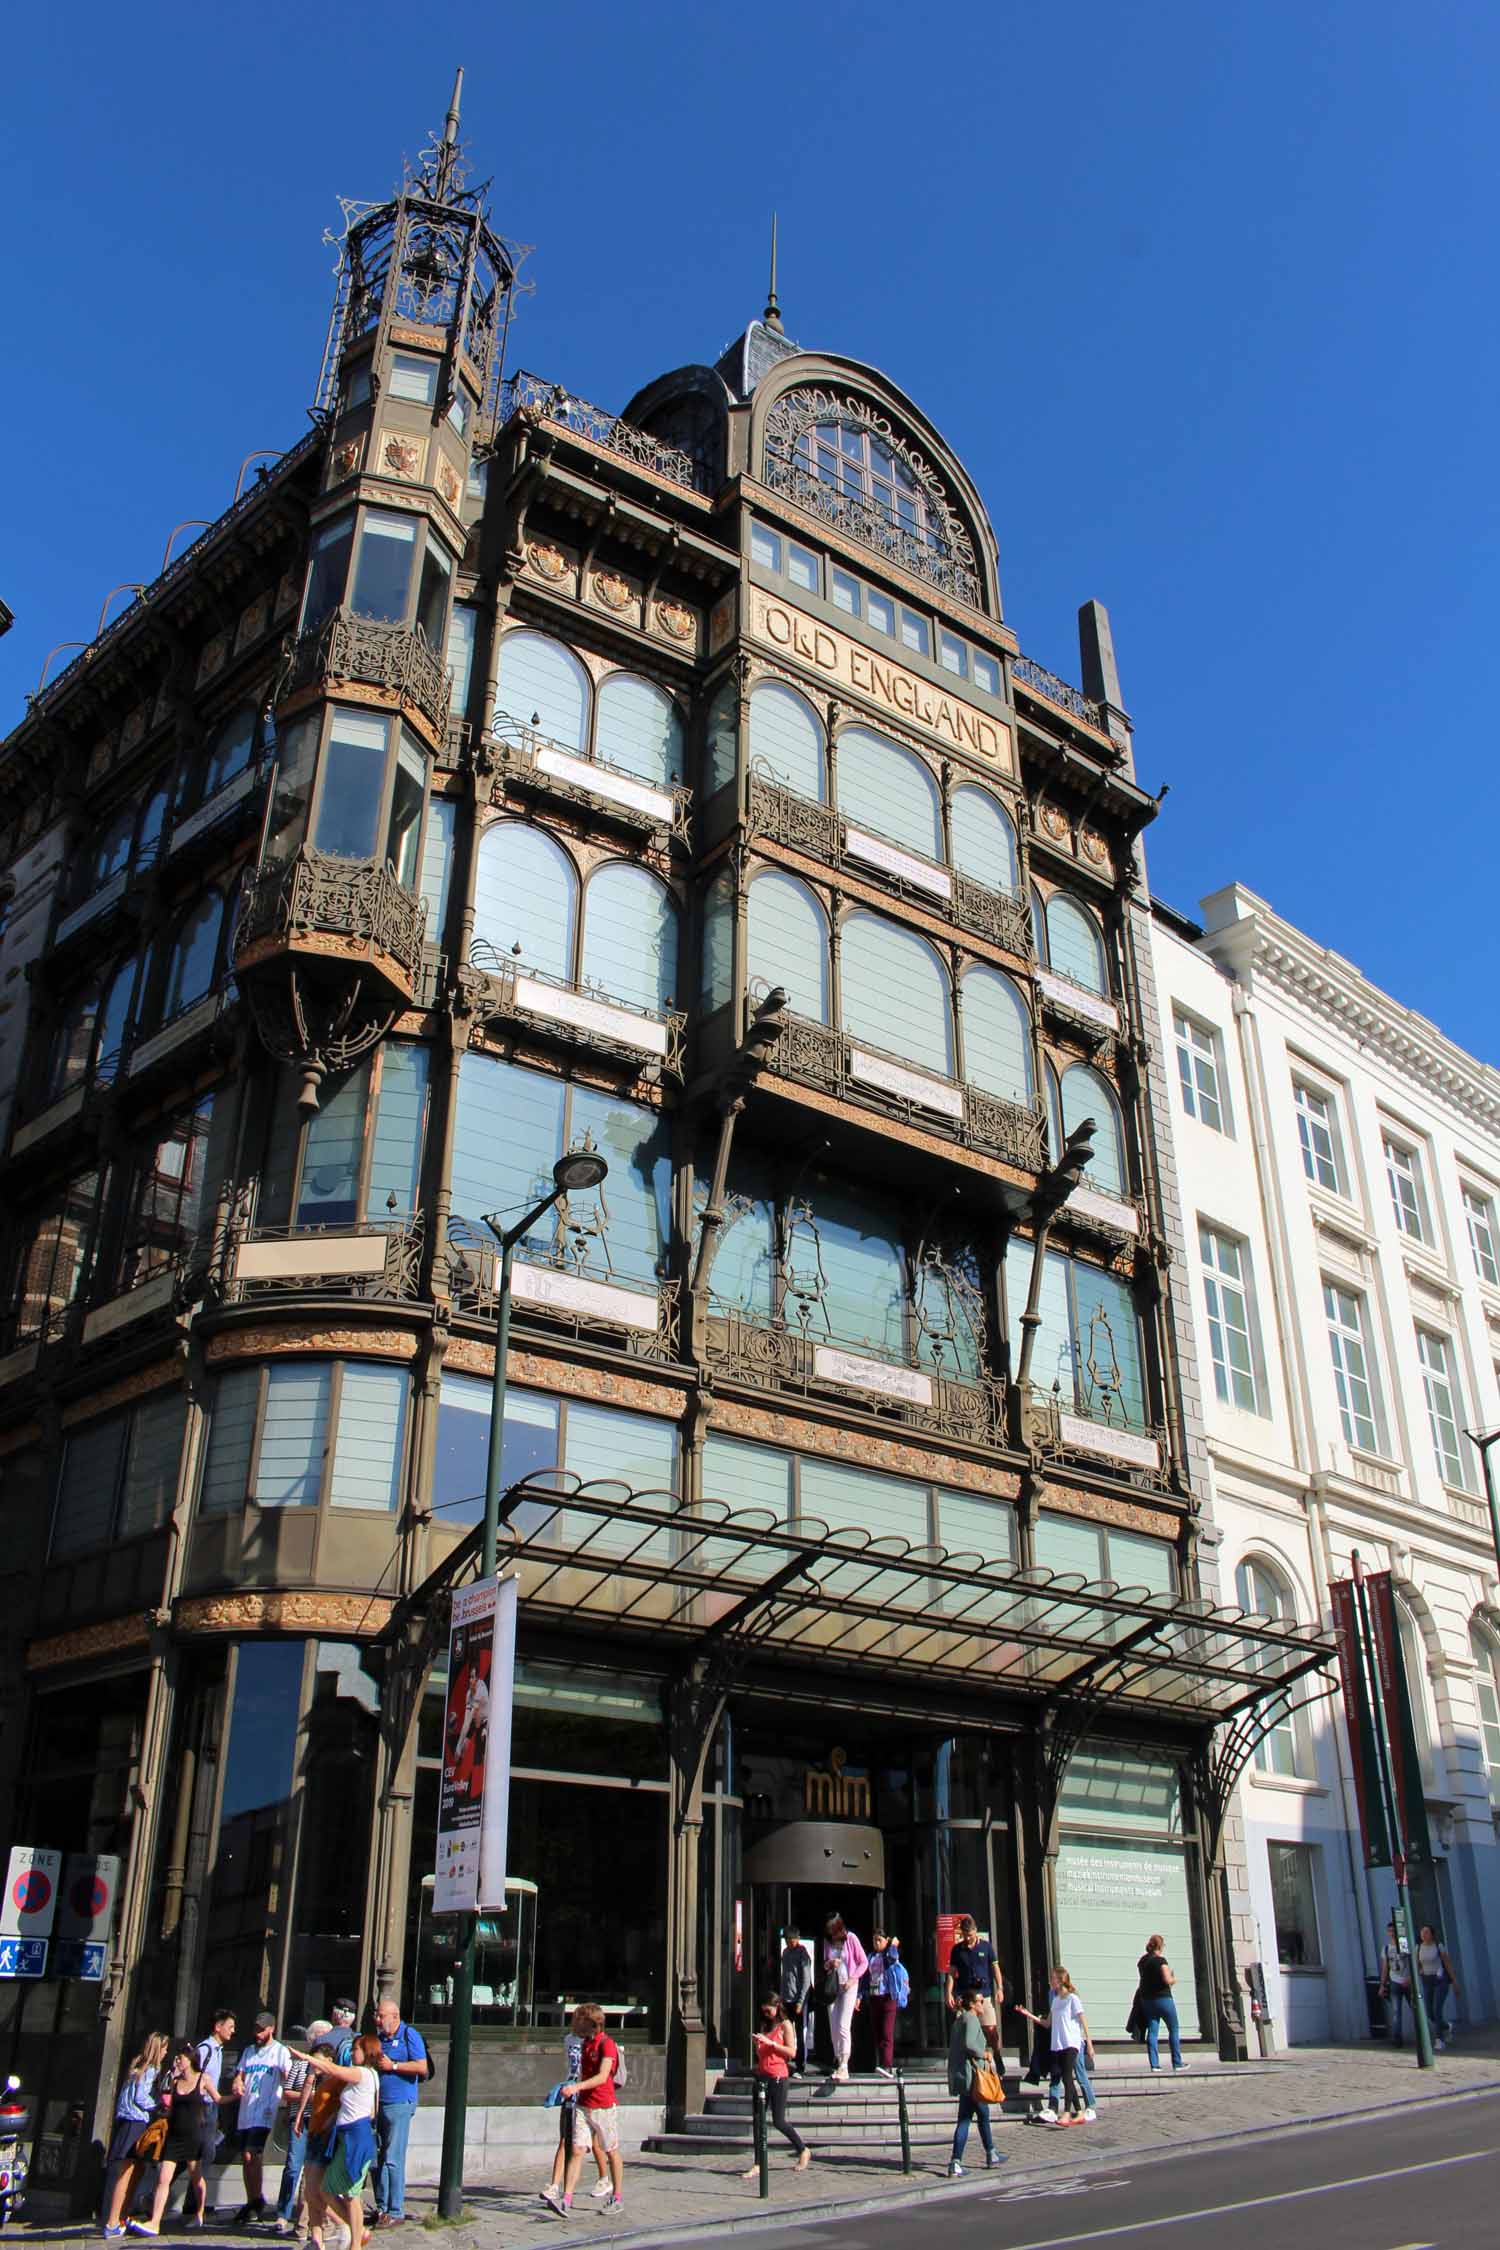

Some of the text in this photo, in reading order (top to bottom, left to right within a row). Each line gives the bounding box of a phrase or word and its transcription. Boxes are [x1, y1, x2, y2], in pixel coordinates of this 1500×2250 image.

[766, 607, 998, 759] OLD ENGLAND
[19, 1852, 56, 1866] ZONE
